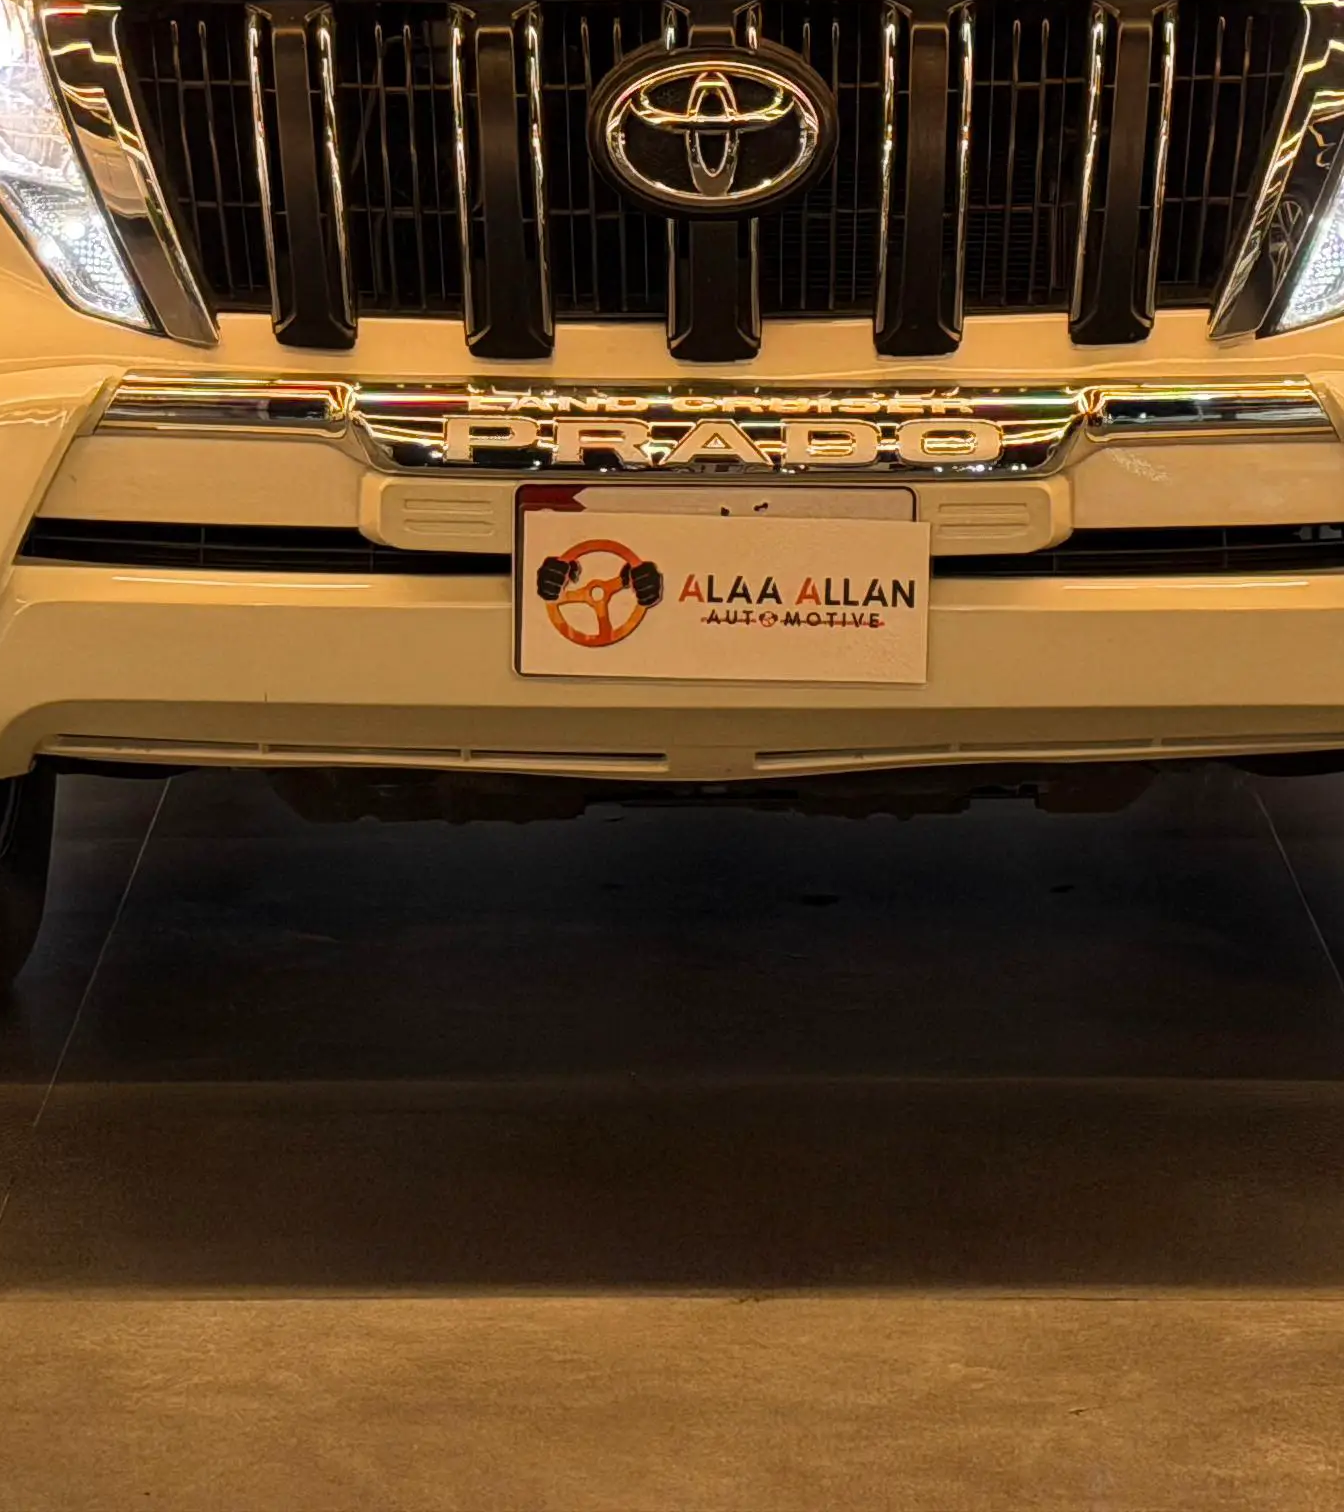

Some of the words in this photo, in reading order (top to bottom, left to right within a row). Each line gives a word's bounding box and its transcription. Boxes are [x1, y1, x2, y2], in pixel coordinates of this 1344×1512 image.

[467, 391, 649, 412] LAND
[672, 393, 973, 414] CRUISER
[443, 415, 1004, 468] PRADO
[678, 574, 783, 605] ALAA
[795, 577, 916, 608] ALLAN
